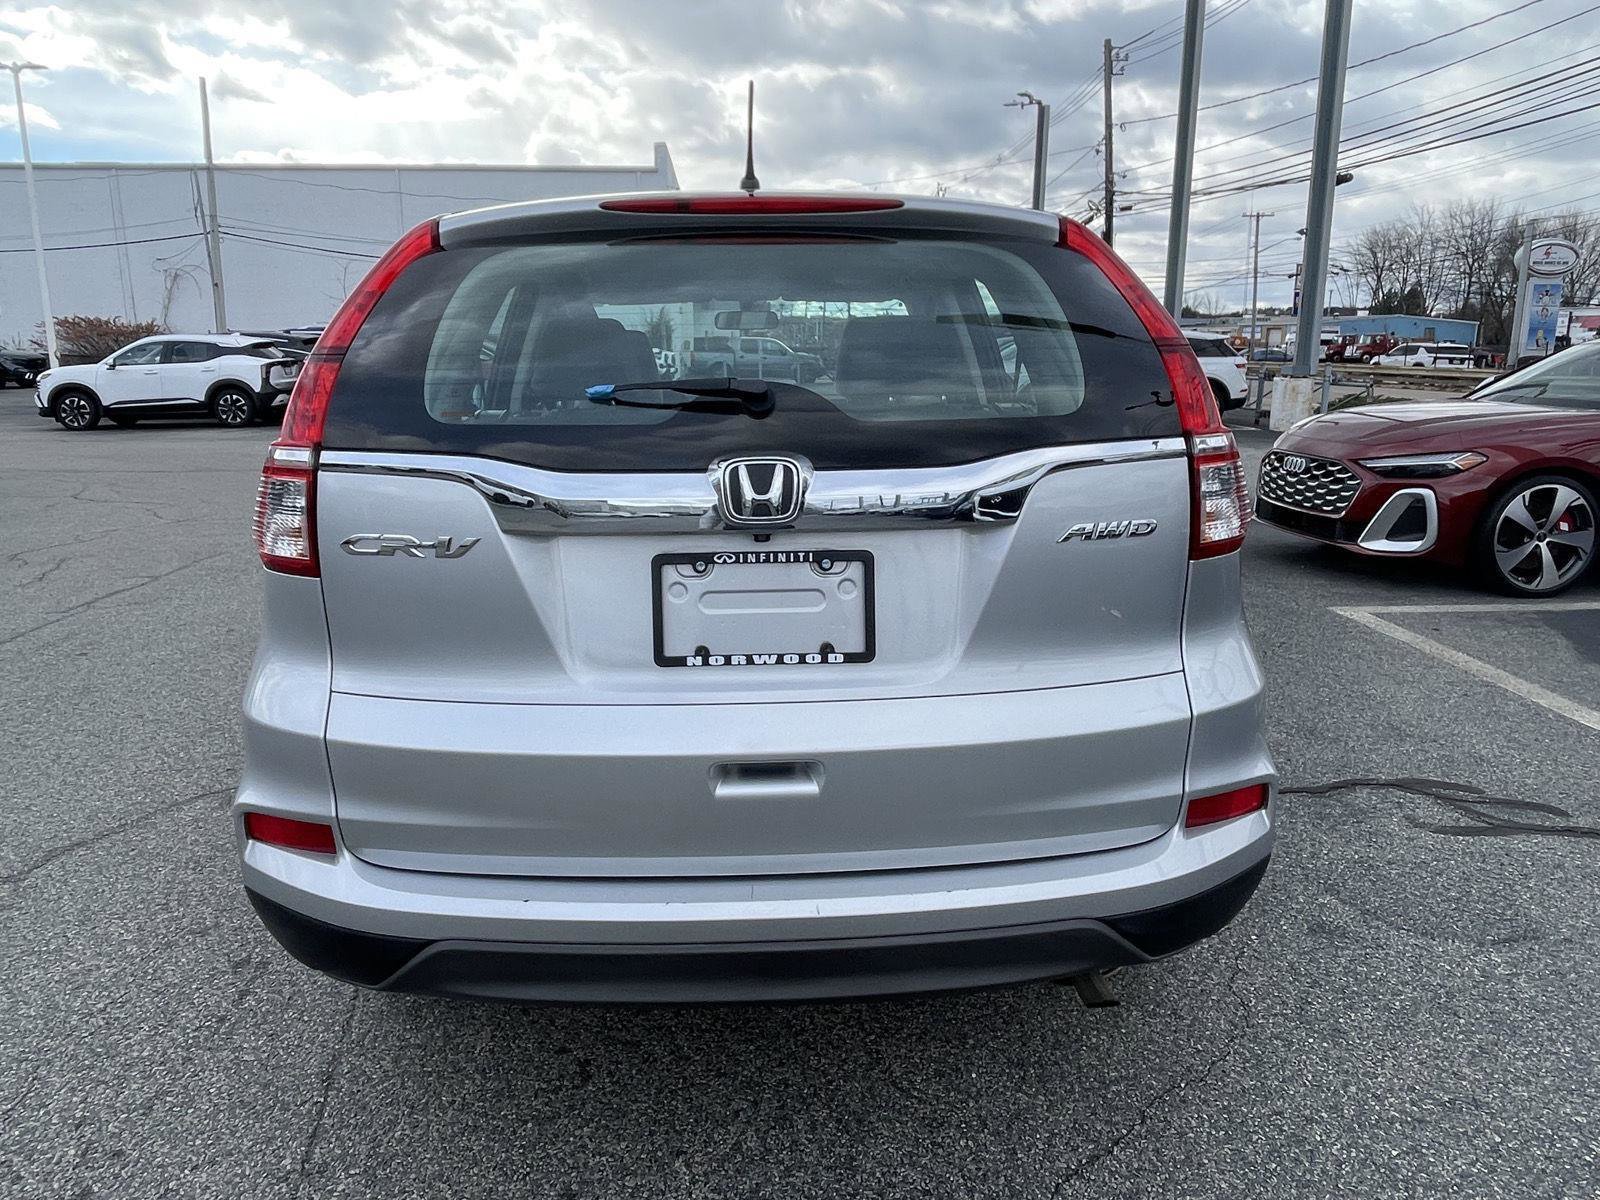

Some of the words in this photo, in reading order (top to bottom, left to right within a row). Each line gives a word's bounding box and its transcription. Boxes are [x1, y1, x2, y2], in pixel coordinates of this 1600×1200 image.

[1056, 519, 1158, 544] AWD
[340, 533, 482, 559] CR-V
[739, 552, 814, 564] INFINITI
[686, 653, 845, 667] NORWOOD
